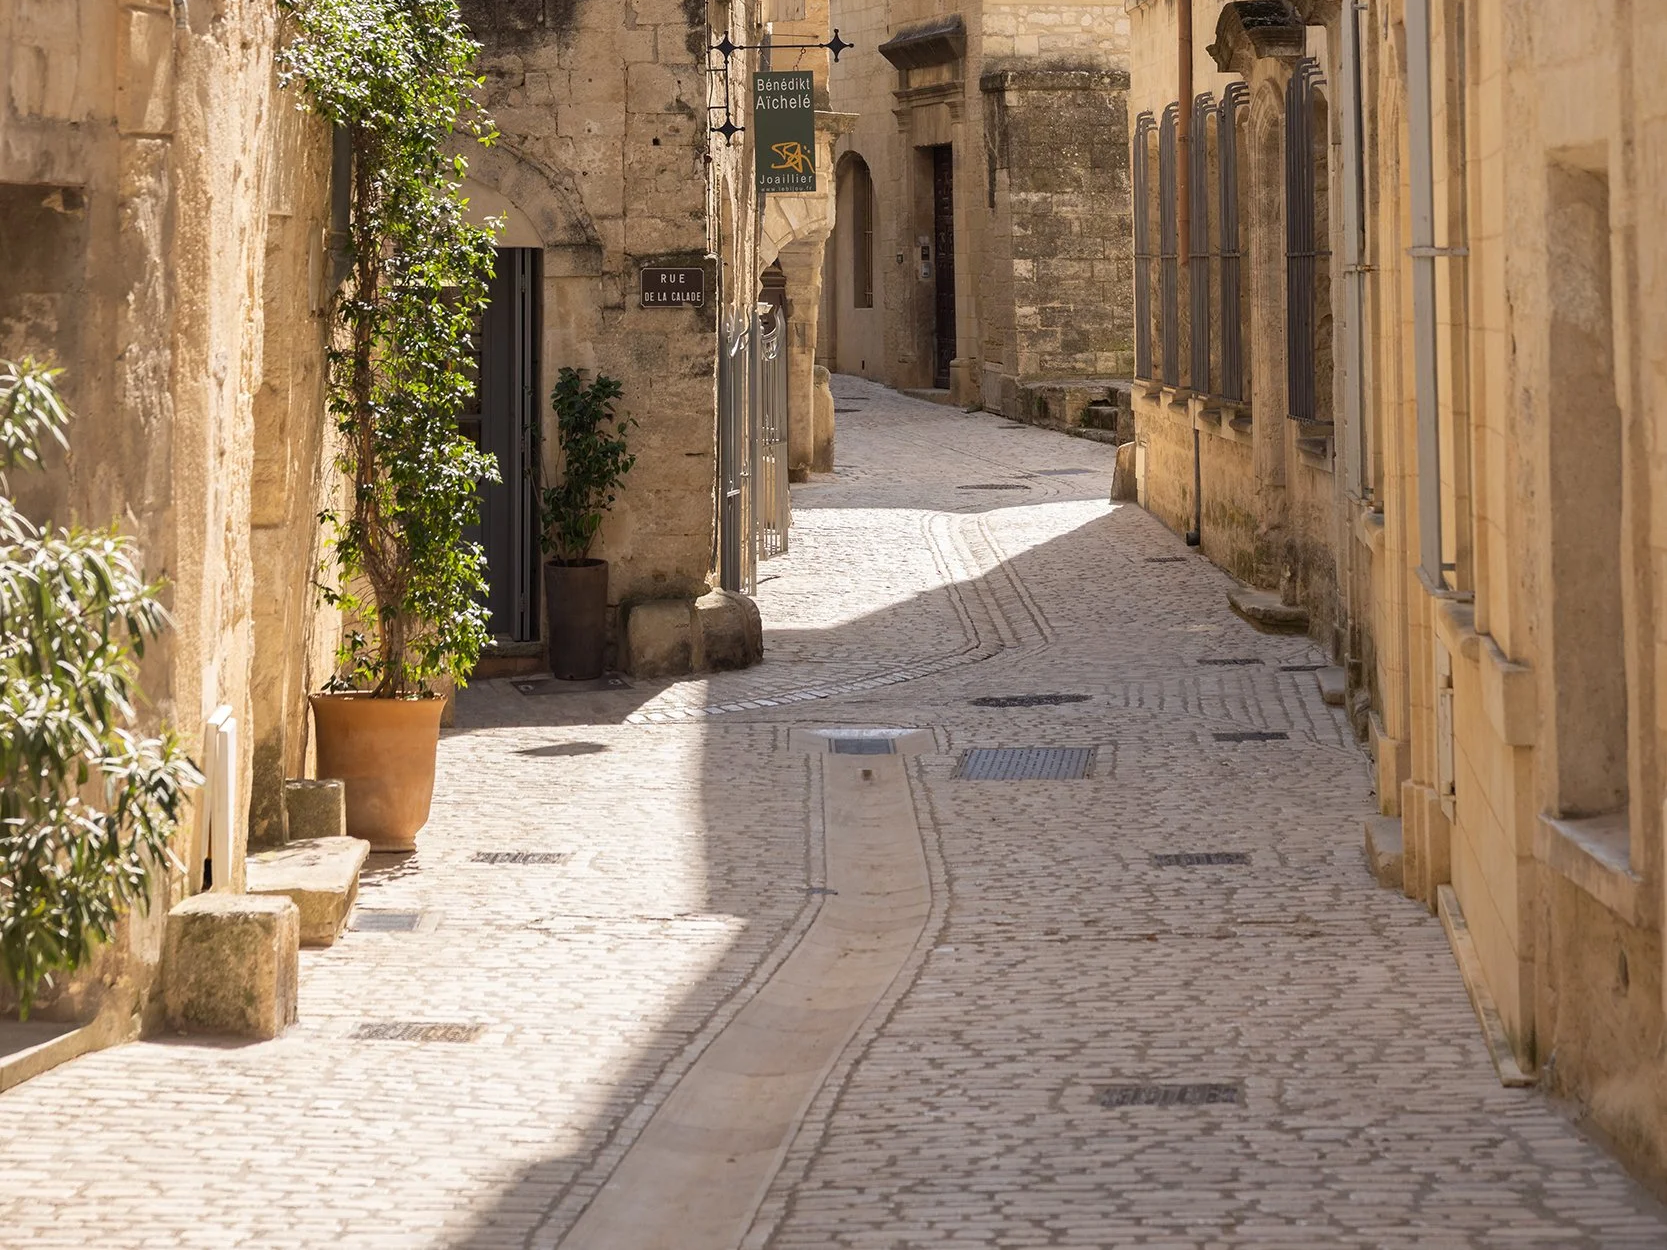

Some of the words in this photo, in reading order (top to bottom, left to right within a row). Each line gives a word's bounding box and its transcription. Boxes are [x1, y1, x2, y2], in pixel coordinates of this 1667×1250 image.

[757, 78, 810, 92] Bénédikt
[756, 94, 811, 110] Aïchelé
[760, 174, 813, 184] Joaillier
[660, 273, 685, 283] RUE
[644, 292, 654, 302] DE
[657, 292, 667, 302] LA
[671, 292, 701, 302] CALADE
